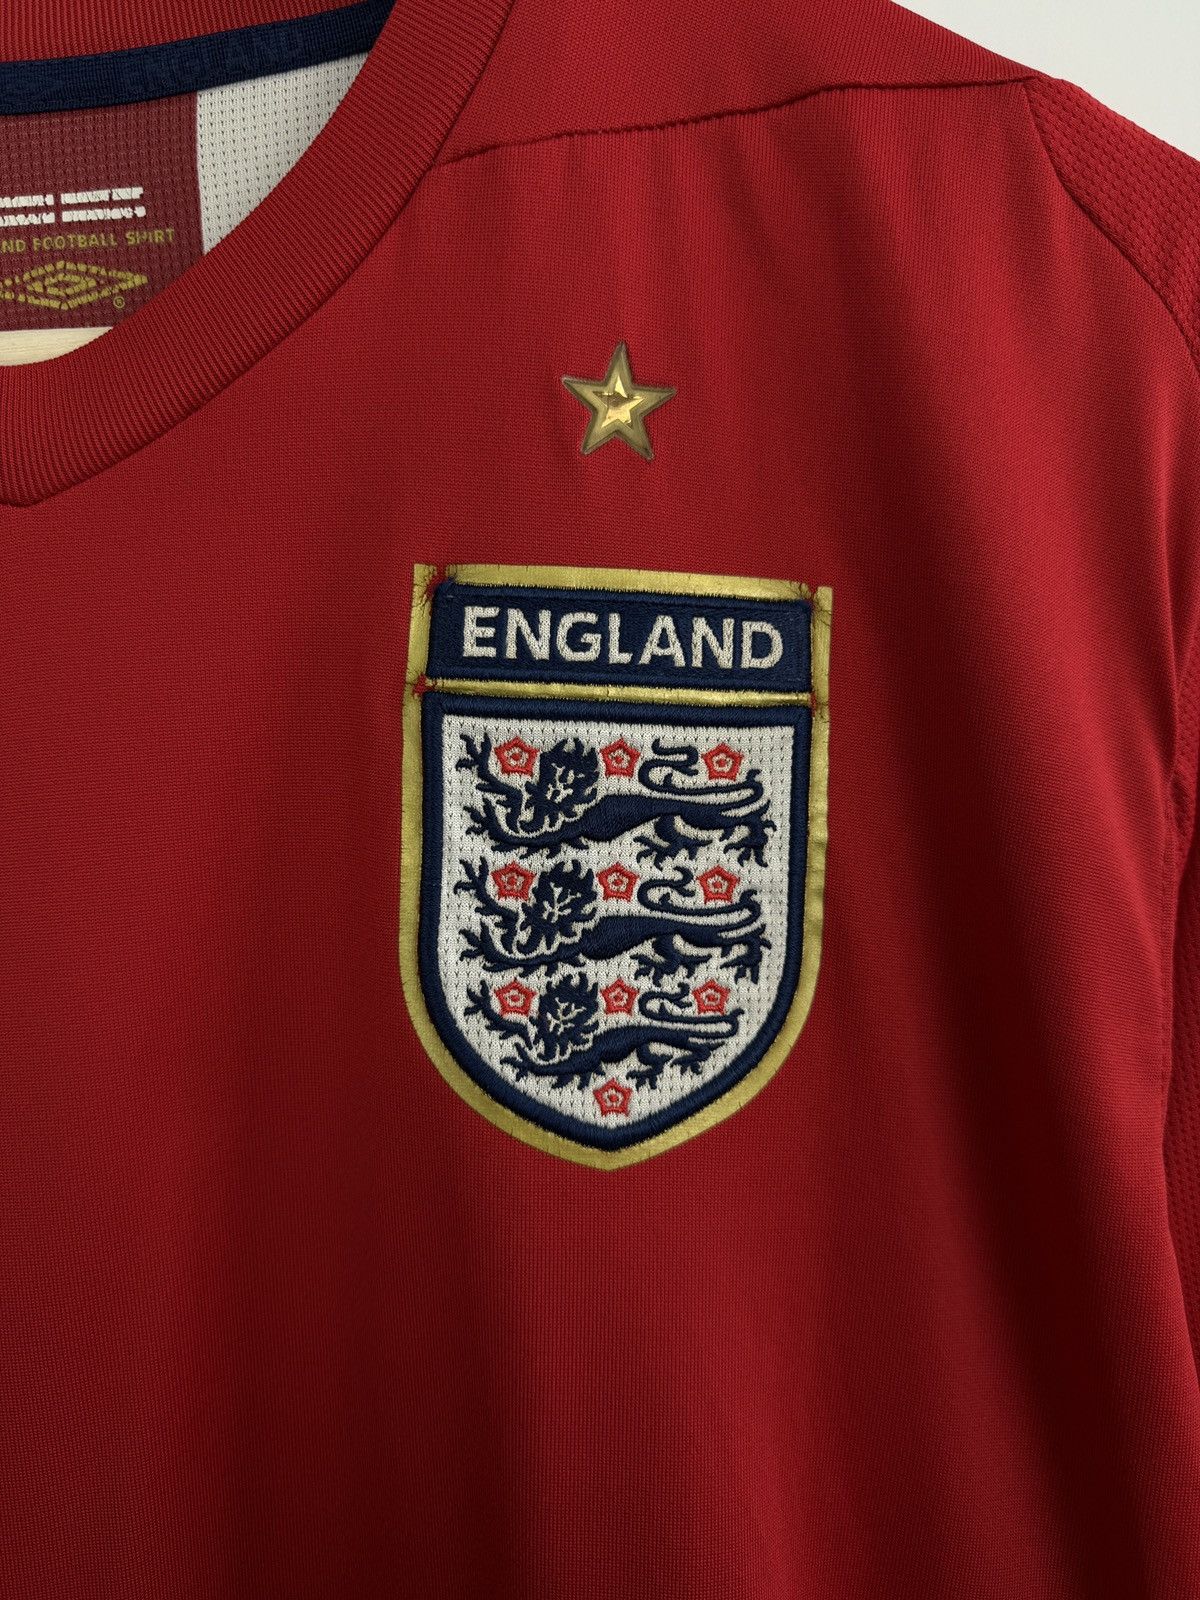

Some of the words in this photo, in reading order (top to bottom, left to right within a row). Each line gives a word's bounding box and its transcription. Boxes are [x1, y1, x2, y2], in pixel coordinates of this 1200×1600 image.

[122, 27, 304, 92] ENGLAND
[33, 233, 118, 251] FOOTBALL
[126, 228, 175, 245] SHIRT
[462, 605, 784, 669] ENGLAND
